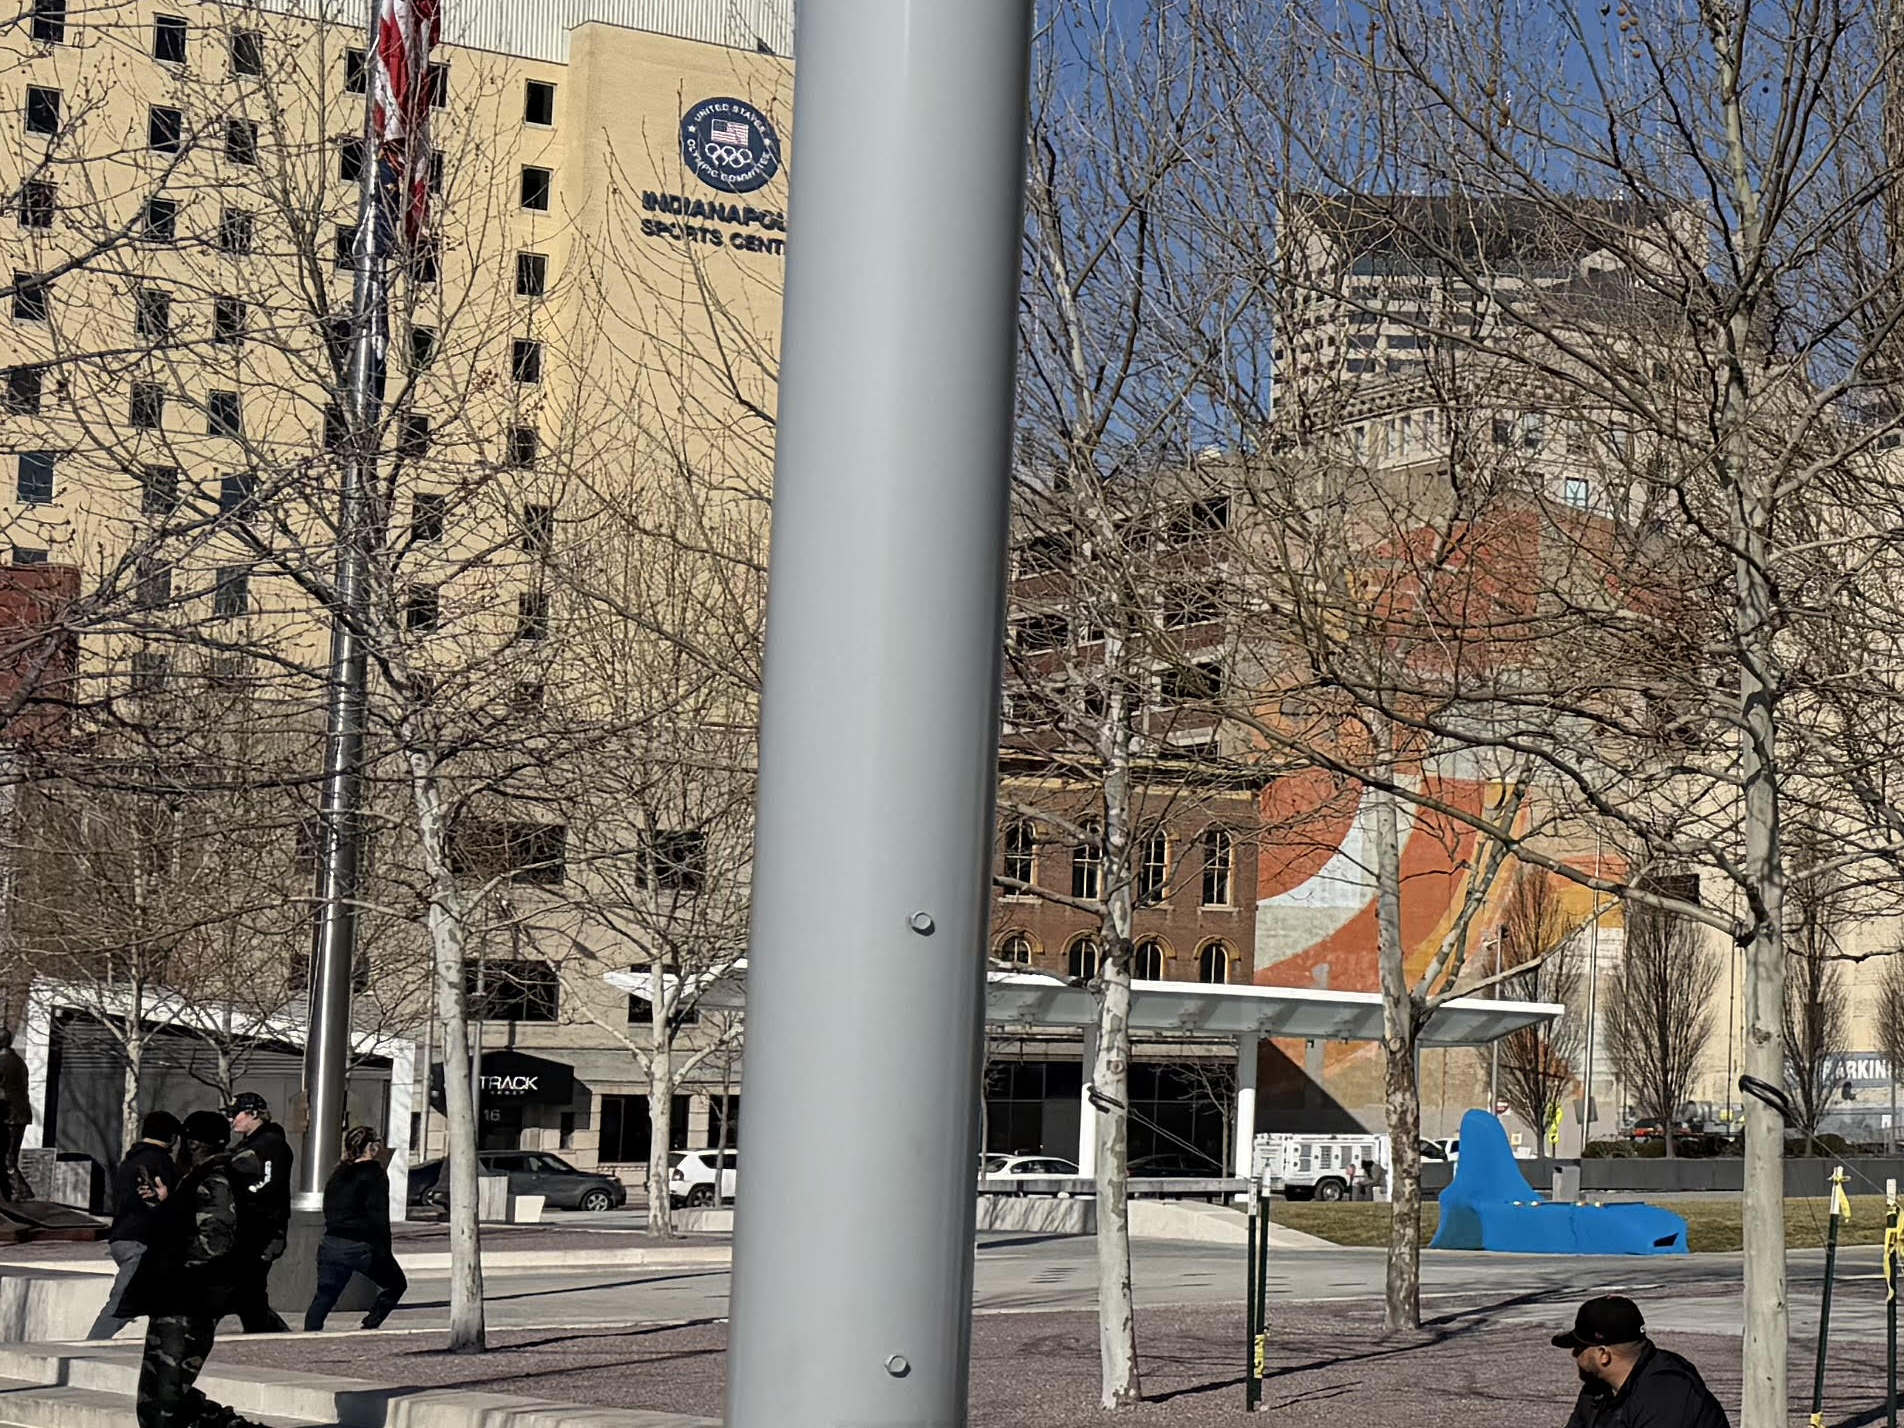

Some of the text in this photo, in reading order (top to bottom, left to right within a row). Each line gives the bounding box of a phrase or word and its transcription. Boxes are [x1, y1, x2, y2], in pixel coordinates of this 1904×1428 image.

[694, 103, 766, 133] UNITED STATES
[640, 218, 724, 247] SPORTS
[479, 1075, 538, 1091] TRACK
